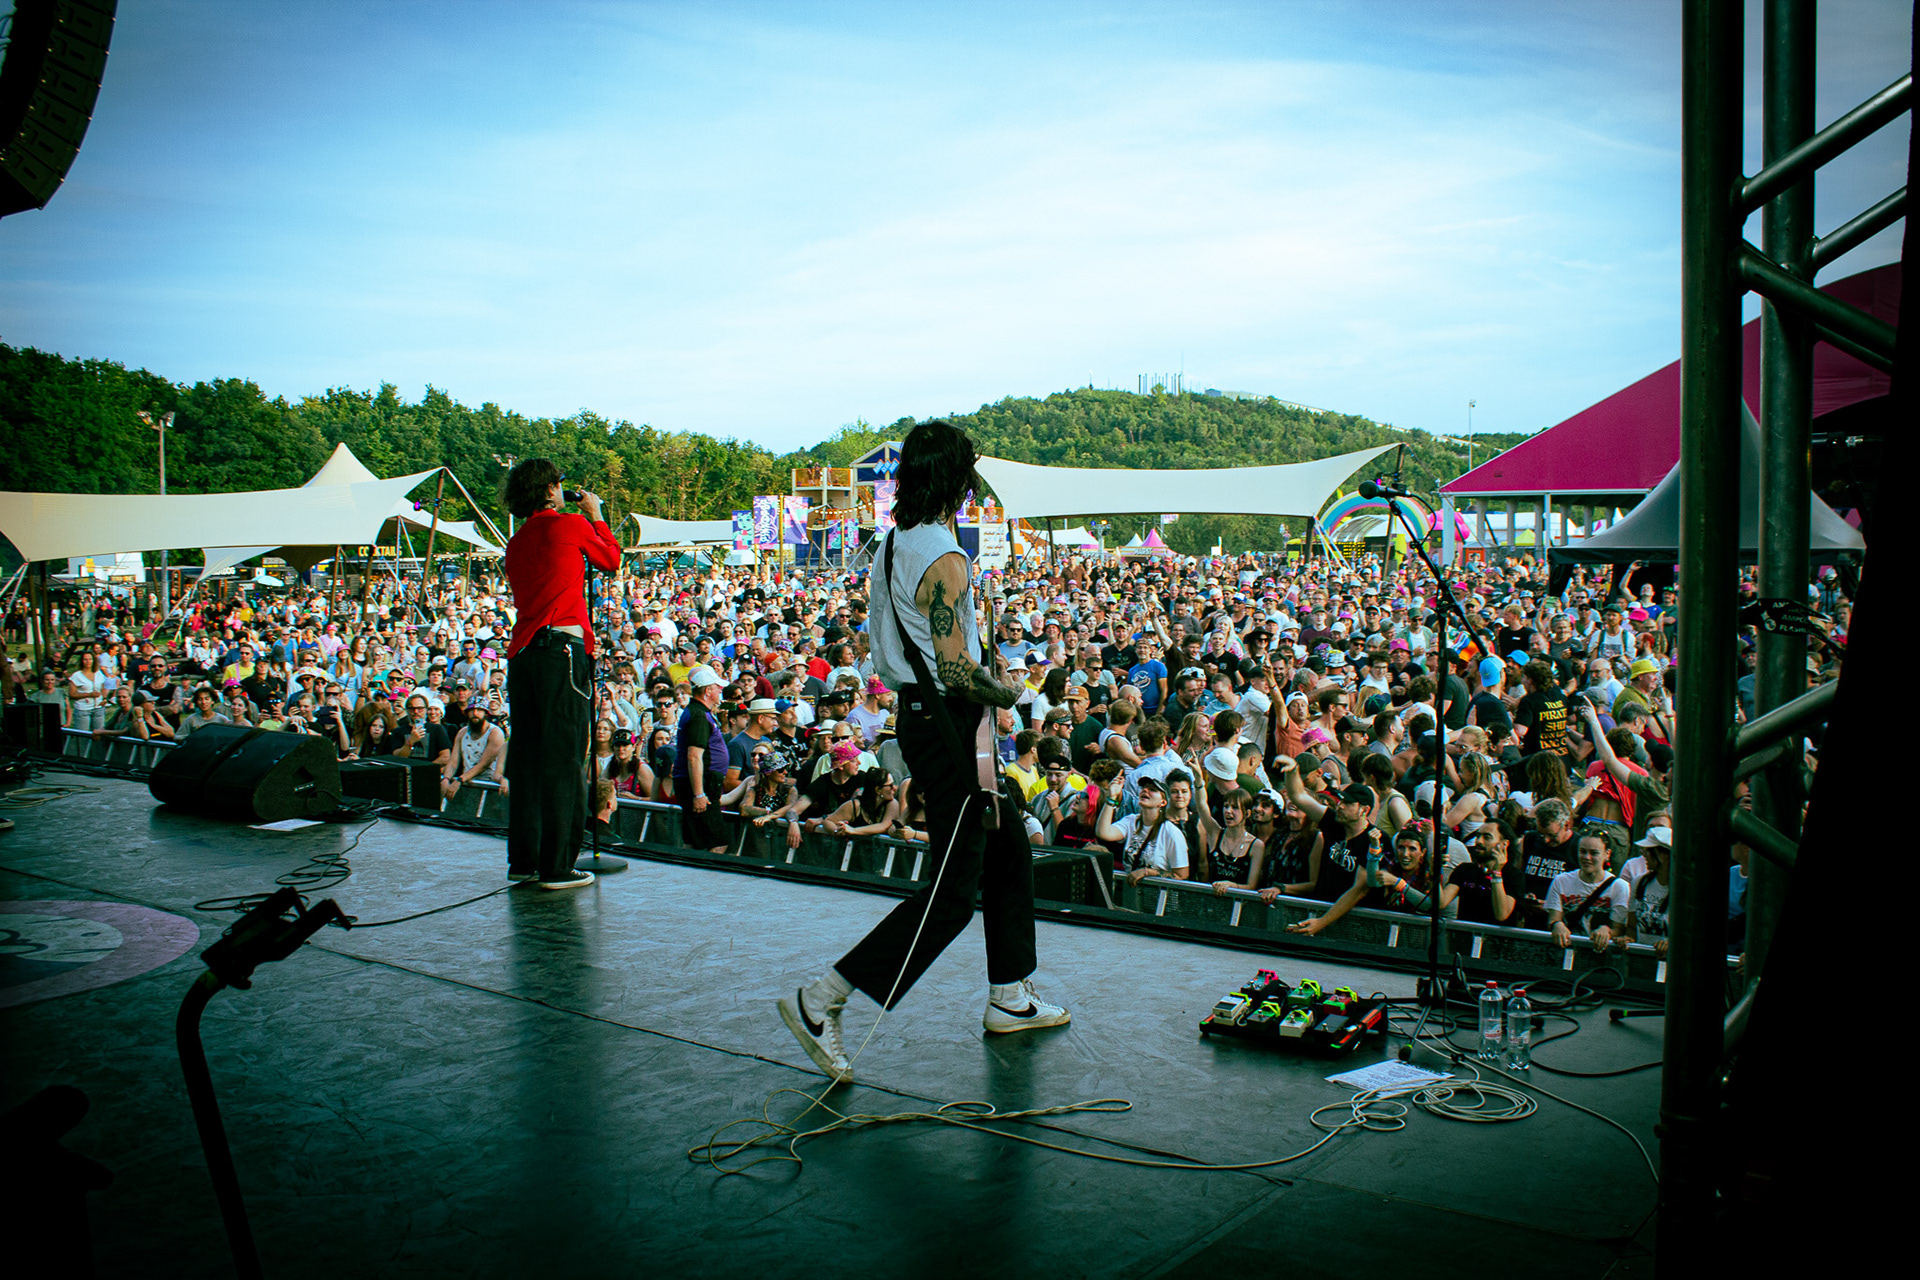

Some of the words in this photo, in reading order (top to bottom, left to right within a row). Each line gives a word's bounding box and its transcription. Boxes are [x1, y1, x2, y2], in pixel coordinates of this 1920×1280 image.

[1528, 855, 1542, 866] NO
[1541, 858, 1567, 871] MUSIC
[1525, 864, 1539, 876] NO
[1537, 867, 1564, 879] GLOR
